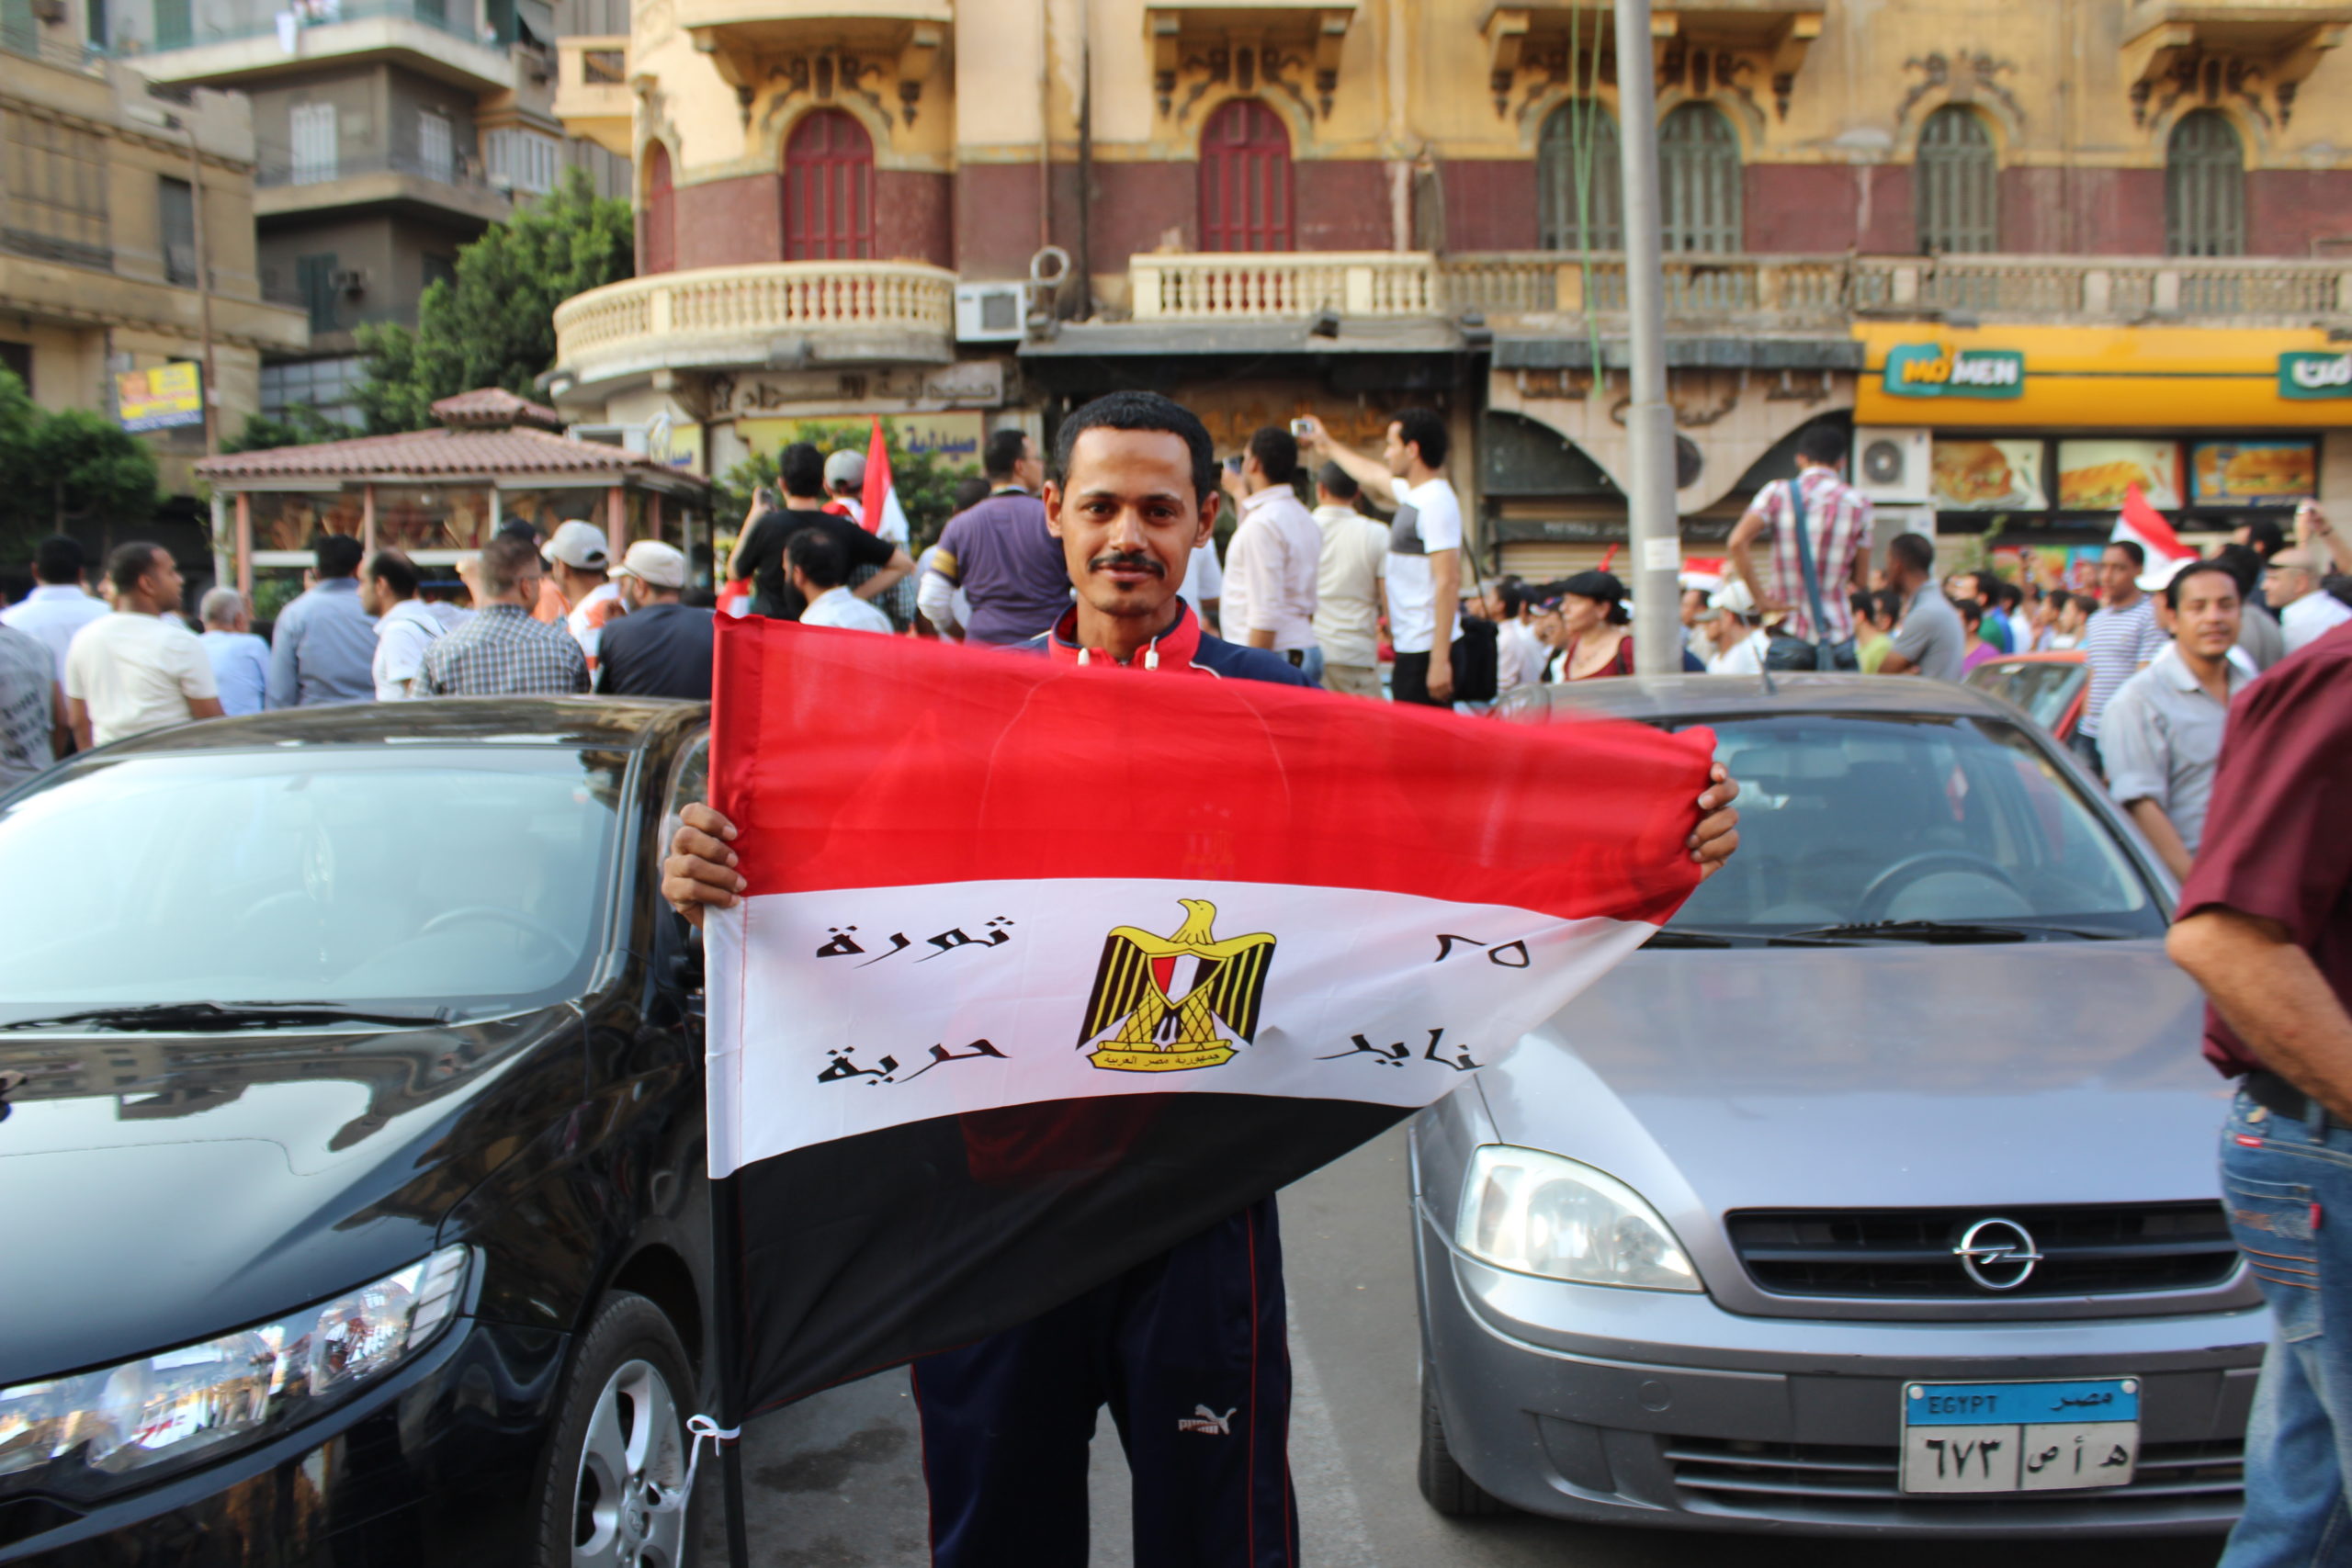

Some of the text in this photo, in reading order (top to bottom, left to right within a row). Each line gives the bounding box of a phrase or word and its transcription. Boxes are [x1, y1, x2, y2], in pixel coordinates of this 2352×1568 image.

[817, 916, 1014, 969] ثورة
[818, 1039, 1012, 1086] حرية
[1103, 1053, 1220, 1066] جمهورية مصر العربية
[1312, 1028, 1485, 1072] ناير
[1928, 1394, 1997, 1415] EGYPT
[2050, 1393, 2113, 1412] مصر
[1926, 1438, 2001, 1479] ٦٧٣
